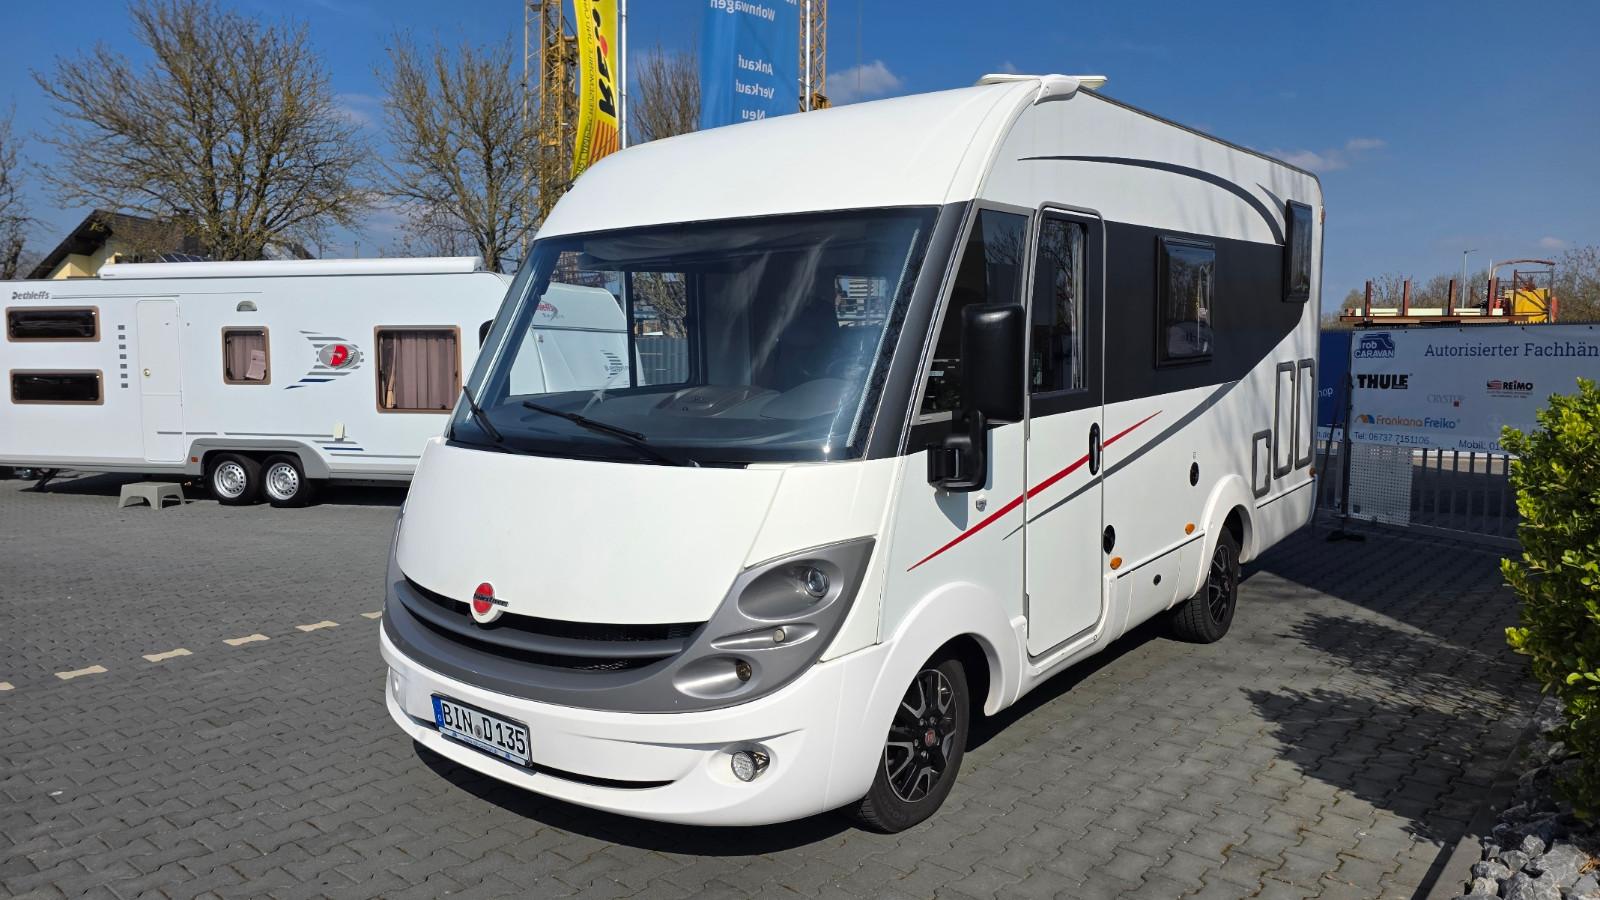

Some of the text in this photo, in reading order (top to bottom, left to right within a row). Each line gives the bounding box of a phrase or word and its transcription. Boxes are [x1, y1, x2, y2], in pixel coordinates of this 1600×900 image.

[11, 291, 50, 300] Dethleffs
[1362, 341, 1378, 349] rob
[1424, 344, 1520, 357] Autorisierter
[1354, 350, 1395, 358] CARAVAN
[1357, 374, 1409, 390] THULE
[442, 702, 474, 735] BIN
